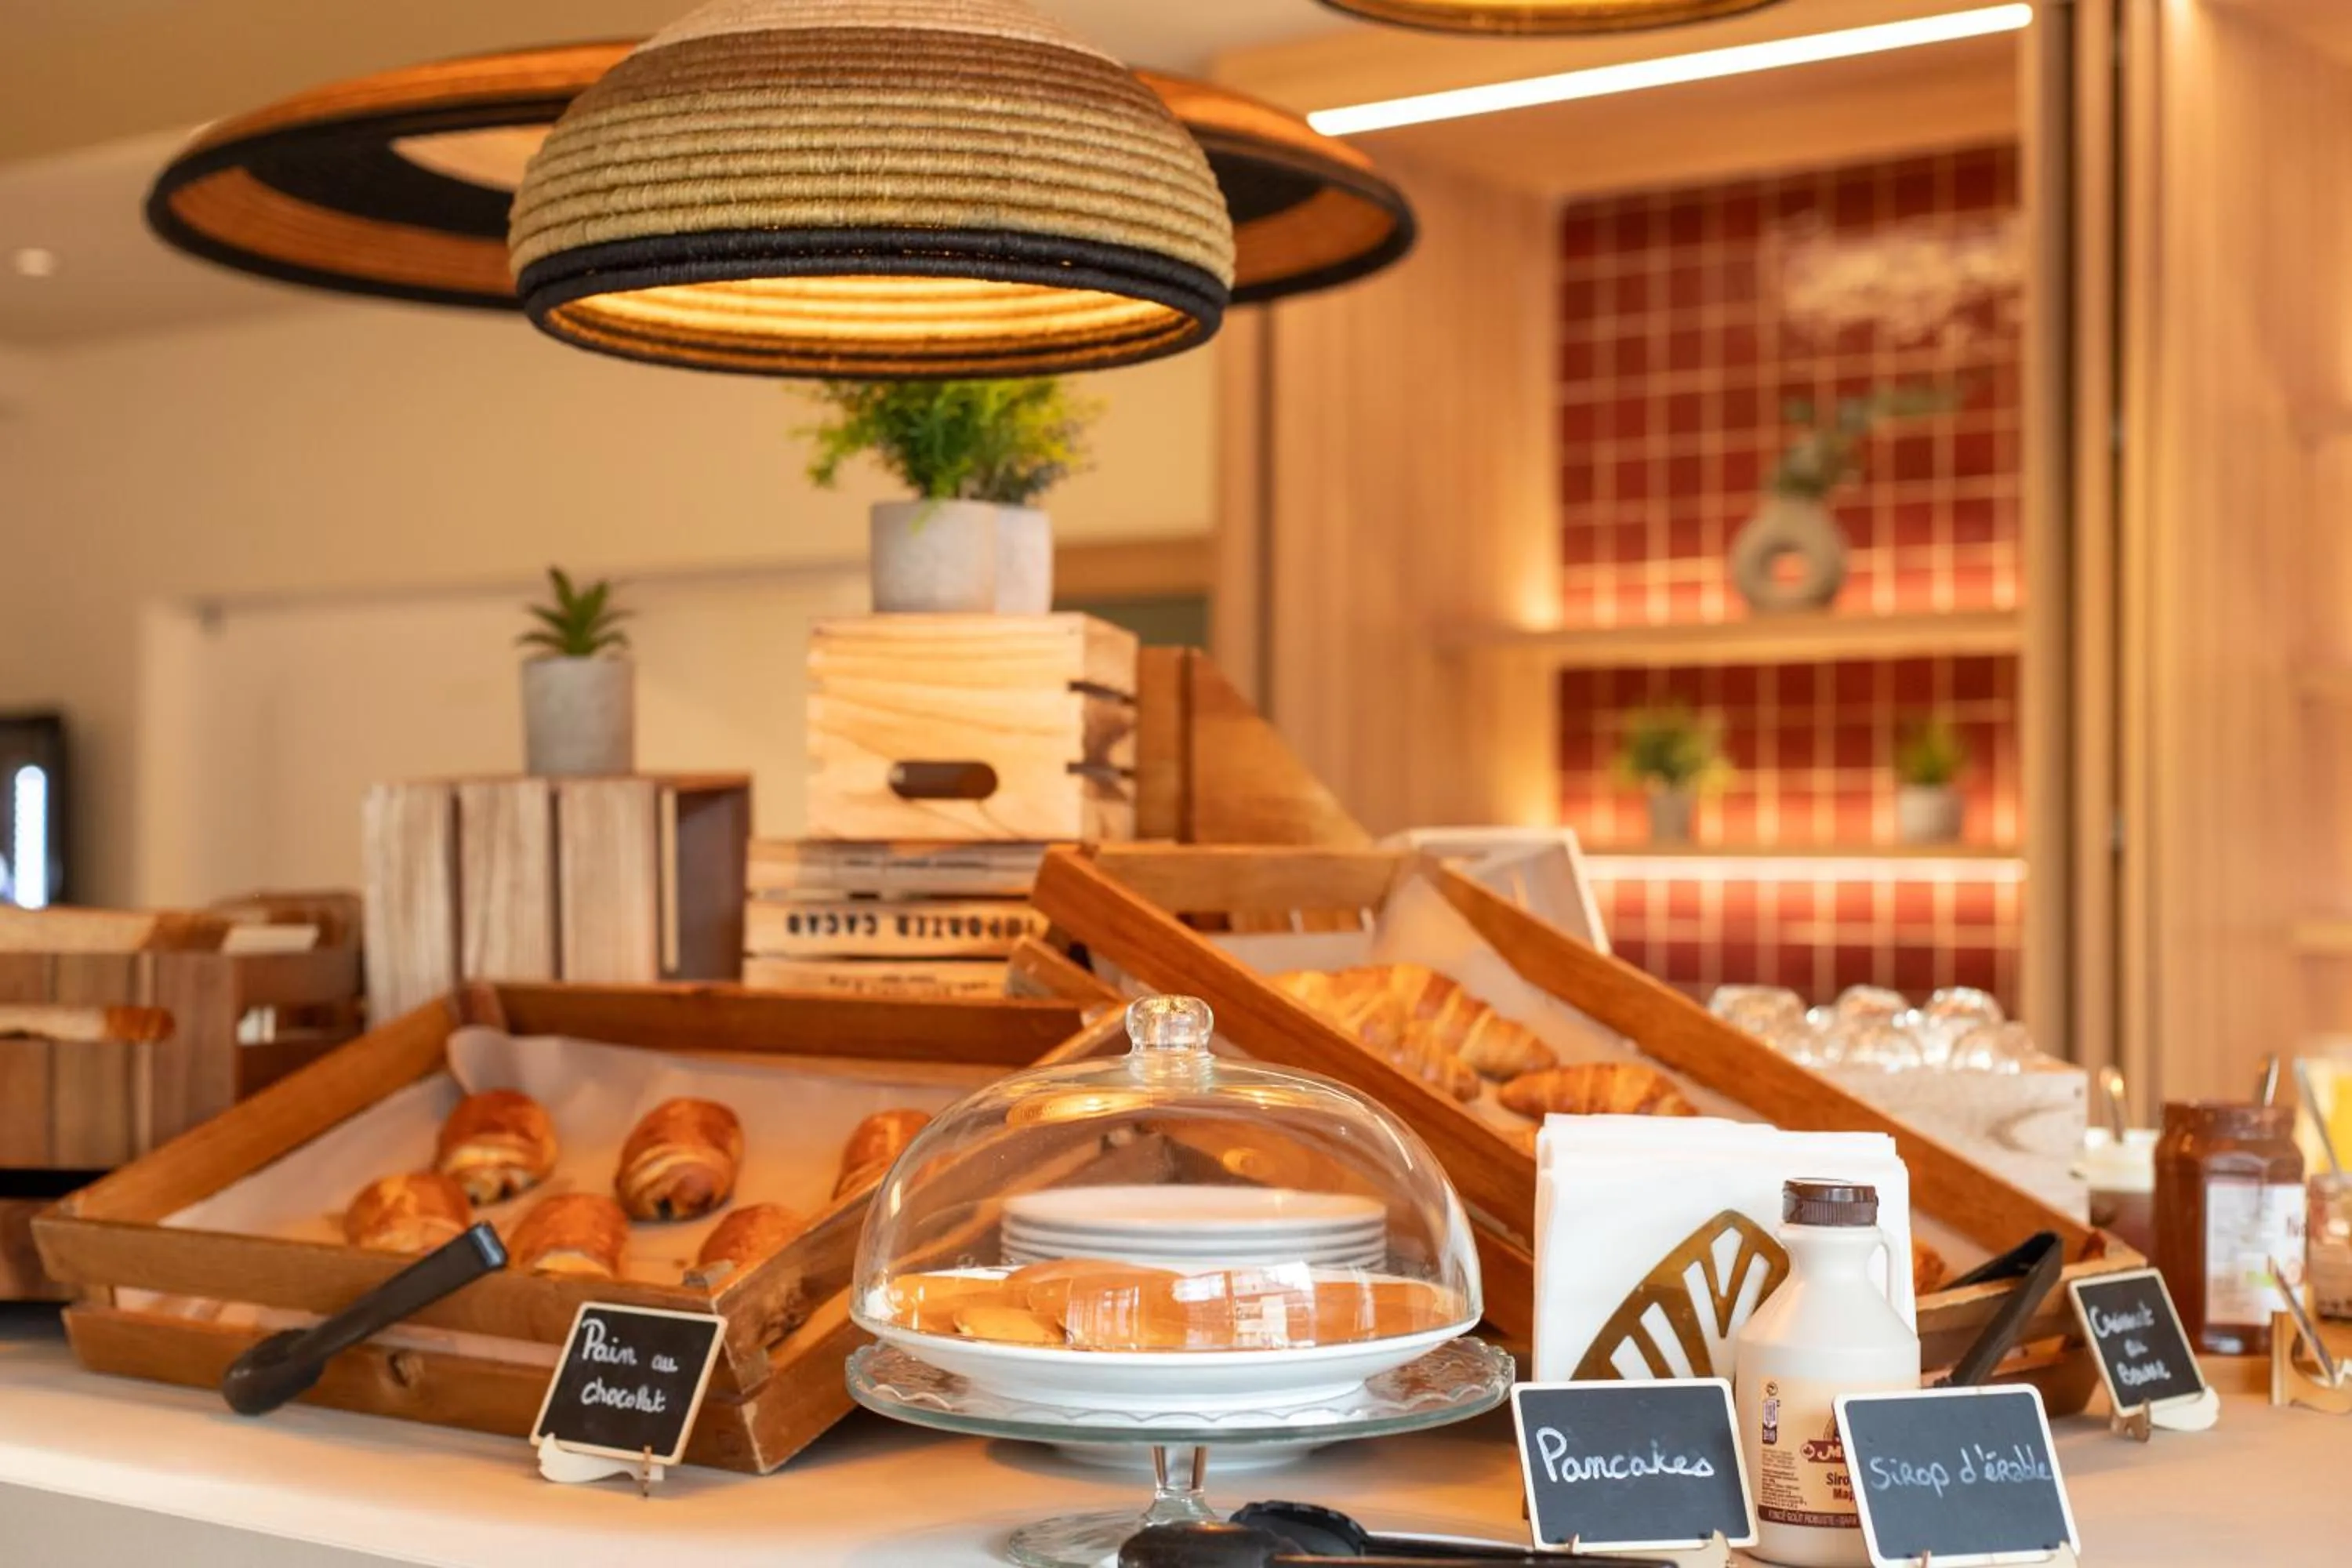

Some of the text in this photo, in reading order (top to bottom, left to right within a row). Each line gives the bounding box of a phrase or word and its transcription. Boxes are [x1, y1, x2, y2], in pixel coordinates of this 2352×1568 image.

[786, 913, 878, 936] CACAO
[582, 1318, 678, 1372] Pain au
[1536, 1426, 1715, 1483] Pancakes
[1826, 1472, 1850, 1486] Siro
[1832, 1488, 1855, 1502] Map
